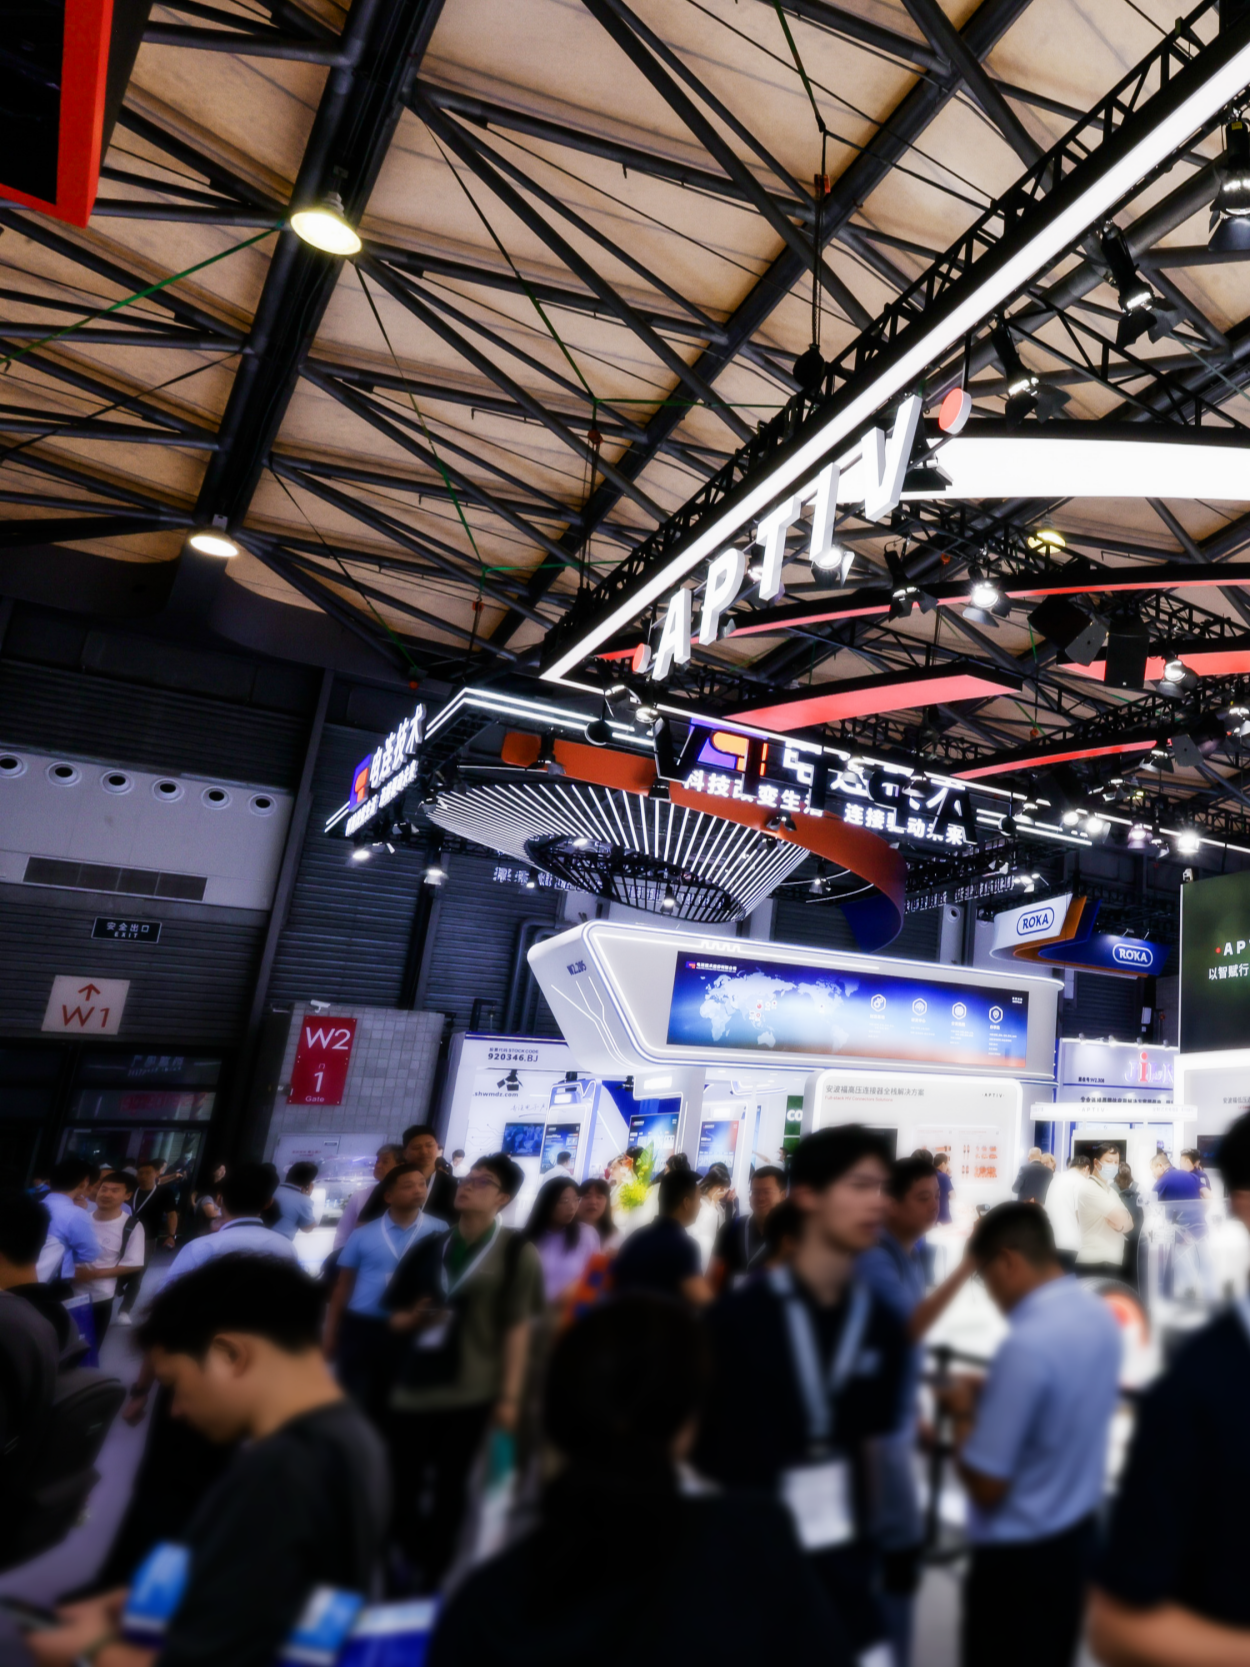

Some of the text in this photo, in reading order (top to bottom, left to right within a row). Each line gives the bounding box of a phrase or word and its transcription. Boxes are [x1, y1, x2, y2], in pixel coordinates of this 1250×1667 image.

[652, 394, 922, 681] APTIV
[106, 922, 150, 933] 安全出口
[1022, 912, 1049, 930] ROKA
[114, 931, 138, 939] EXIT
[1118, 947, 1148, 963] ROKA
[1208, 963, 1249, 980] 以智赋行
[62, 1004, 110, 1028] W1
[306, 1026, 351, 1050] W2
[488, 1053, 539, 1062] 920346.BJ
[314, 1071, 324, 1093] 1
[305, 1095, 325, 1103] Gate
